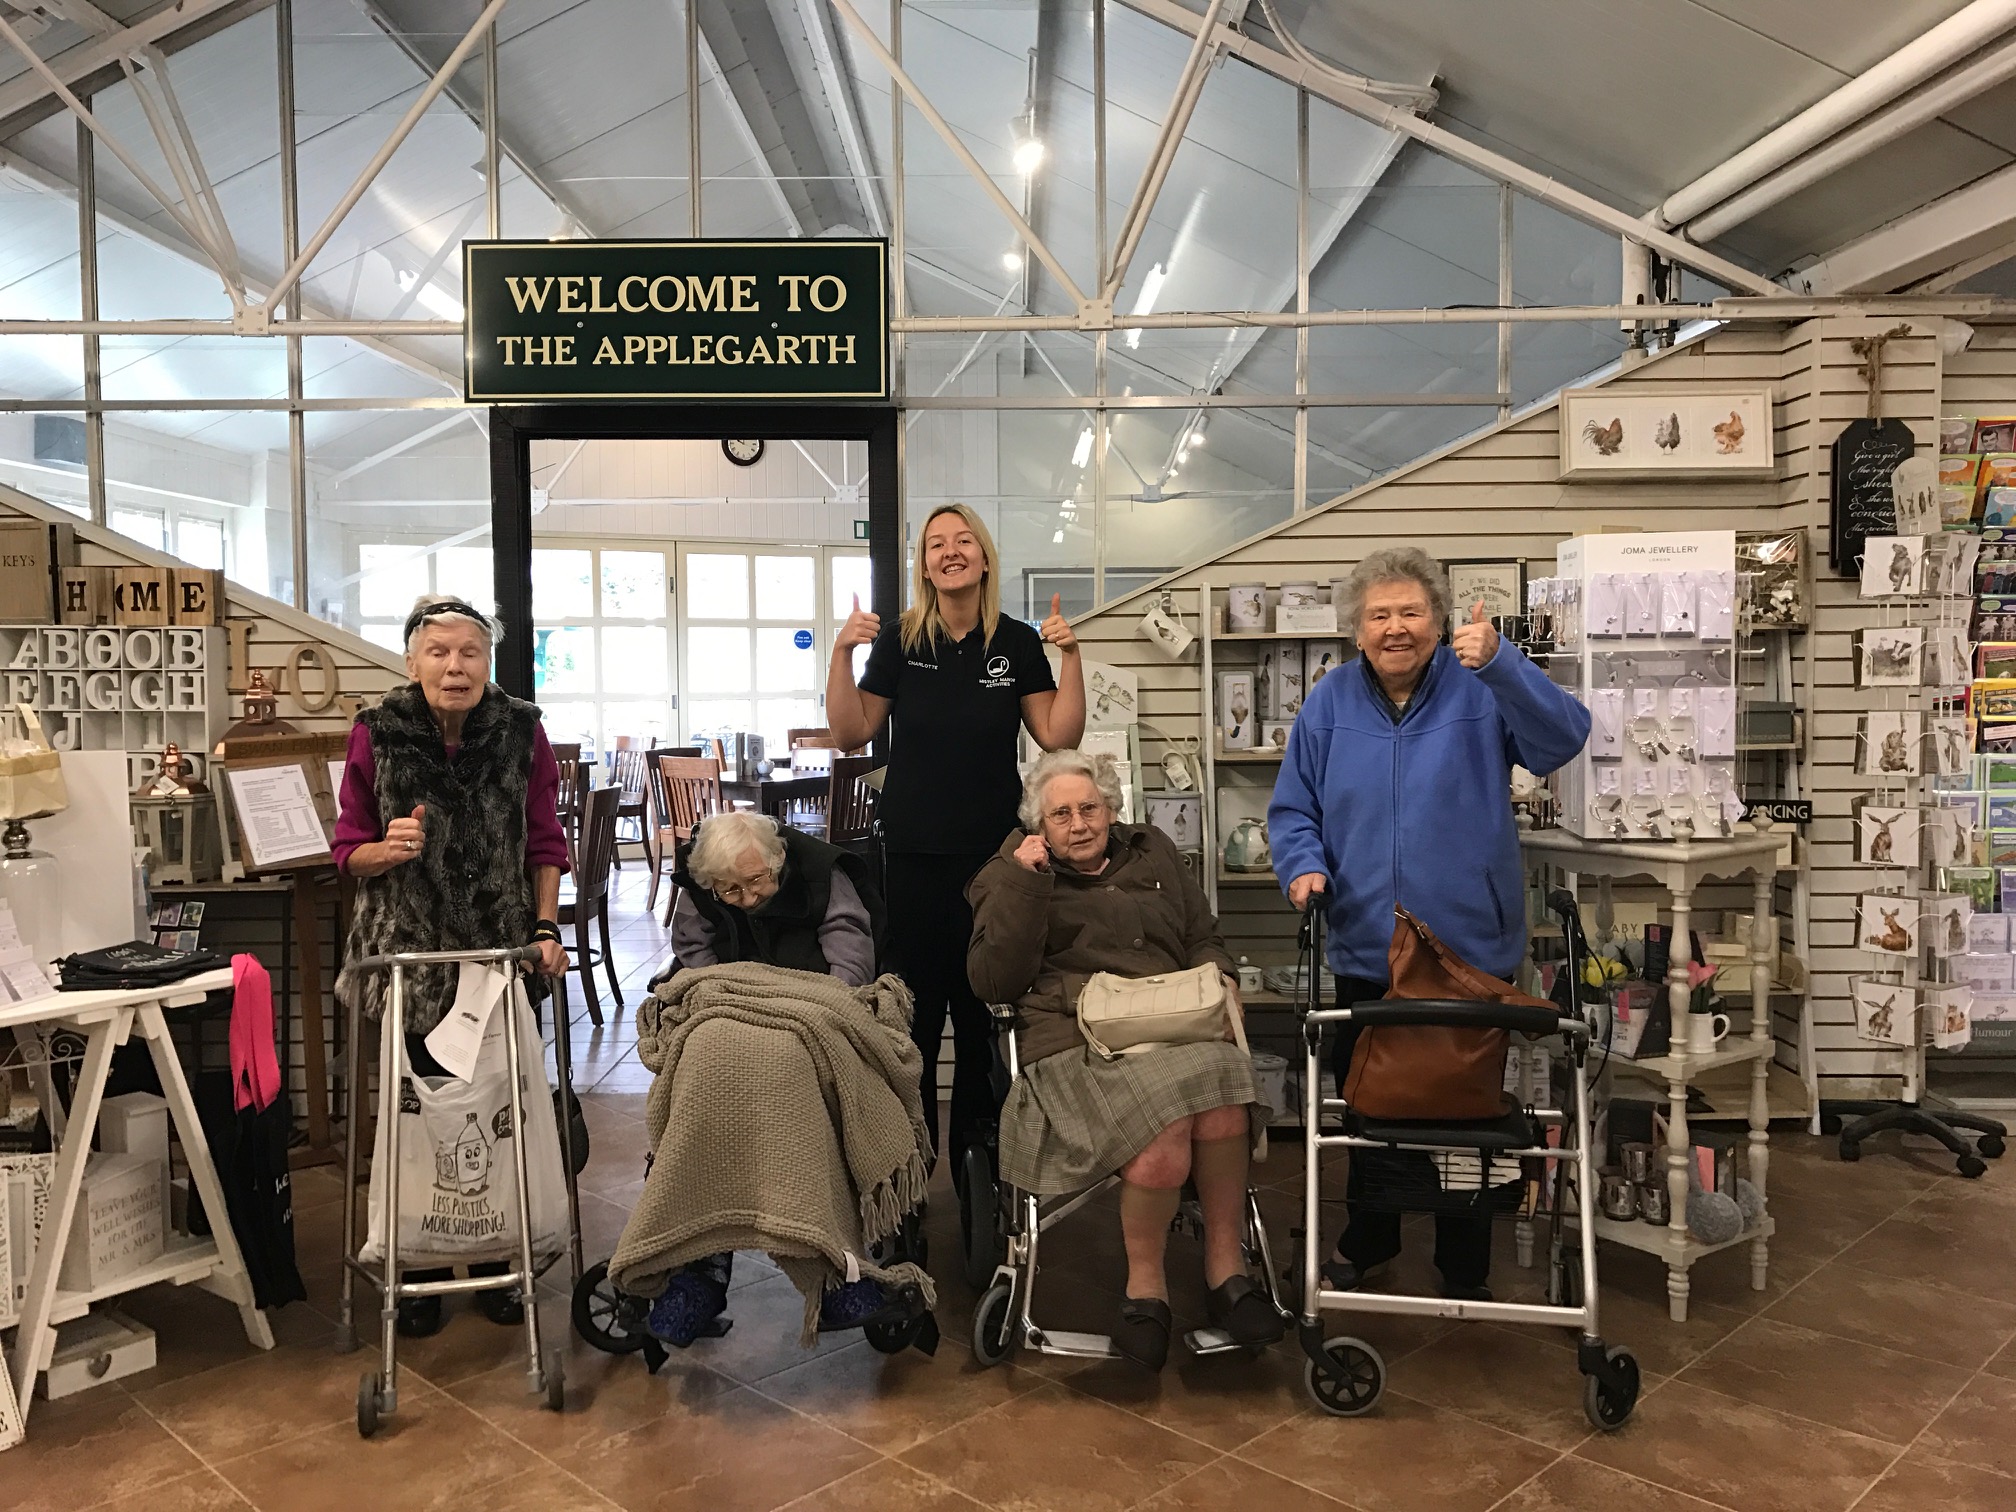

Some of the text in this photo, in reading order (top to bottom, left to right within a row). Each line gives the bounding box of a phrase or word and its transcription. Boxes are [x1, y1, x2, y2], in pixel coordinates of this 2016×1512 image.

[505, 274, 848, 313] WELCOME TO
[497, 334, 857, 366] THE APPLEGARTH
[1648, 545, 1699, 554] JEWELLERY
[2, 555, 35, 567] KEYS
[1458, 590, 1471, 599] ALL
[1488, 586, 1512, 599] THINGS
[907, 660, 939, 670] CHARLOTTE
[1611, 923, 1638, 933] ABY
[432, 1193, 450, 1214] LESS
[421, 1211, 507, 1237] MORE SHOPPING!
